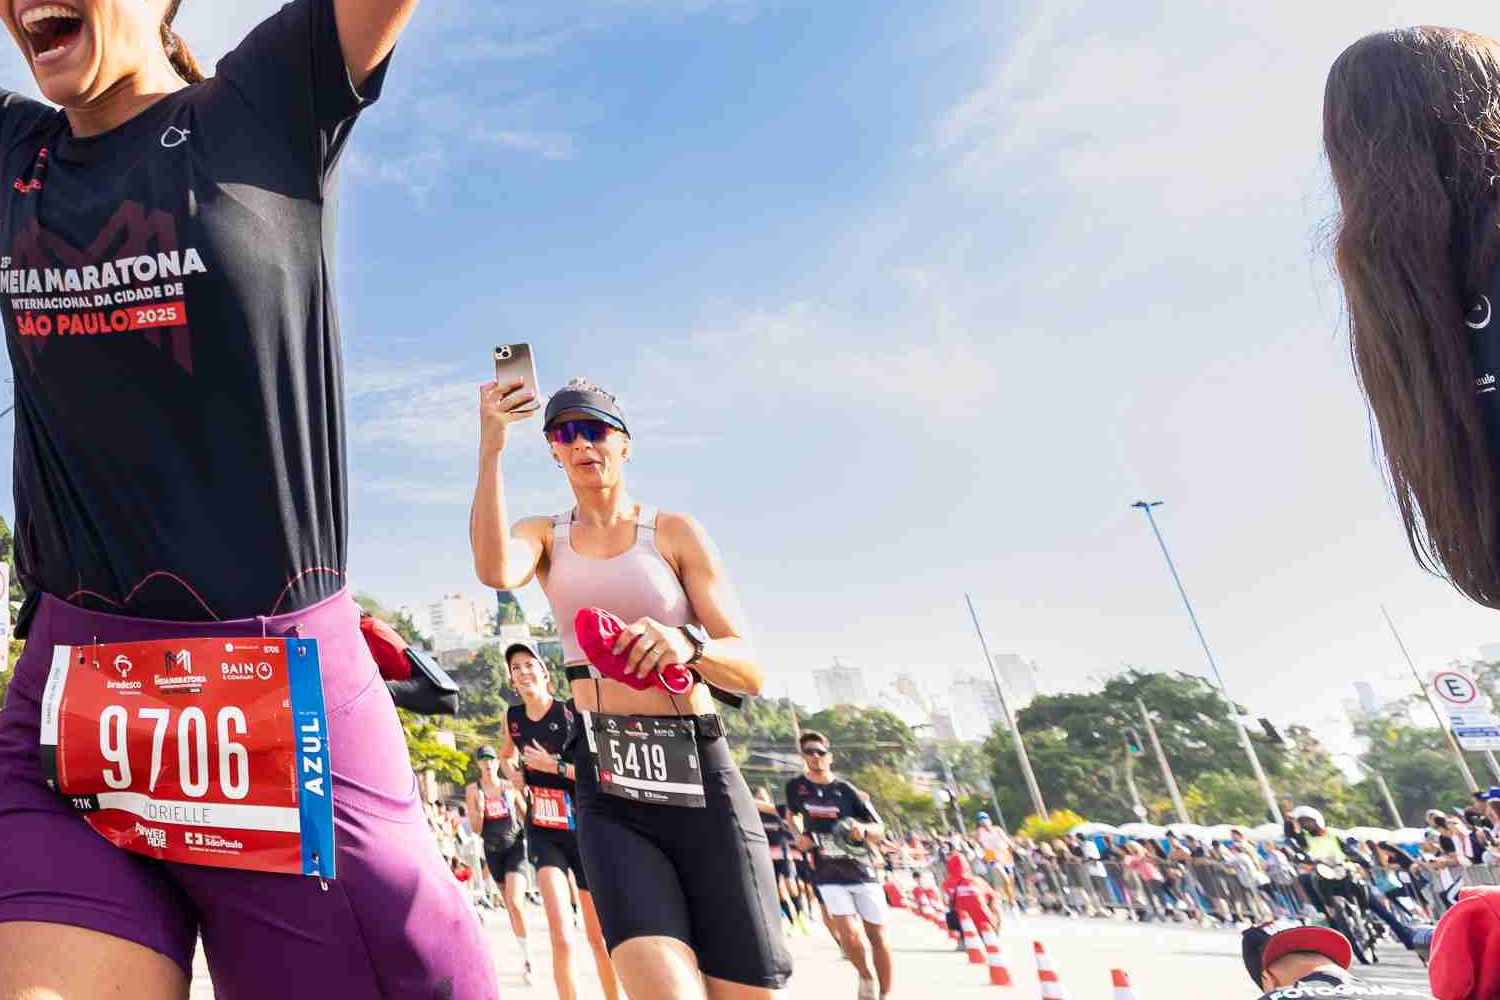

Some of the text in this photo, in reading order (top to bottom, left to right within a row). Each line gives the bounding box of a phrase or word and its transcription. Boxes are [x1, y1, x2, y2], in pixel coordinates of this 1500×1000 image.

[0, 248, 207, 293] MEIA MARATONA
[11, 282, 184, 310] INTERNACIONAL DA CIDADE DE
[16, 307, 177, 336] SÃO PAULO 2025
[222, 663, 254, 674] BAIN
[1444, 679, 1466, 697] E
[100, 705, 250, 800] 9706
[300, 717, 325, 798] AZUL
[609, 739, 668, 782] 5419
